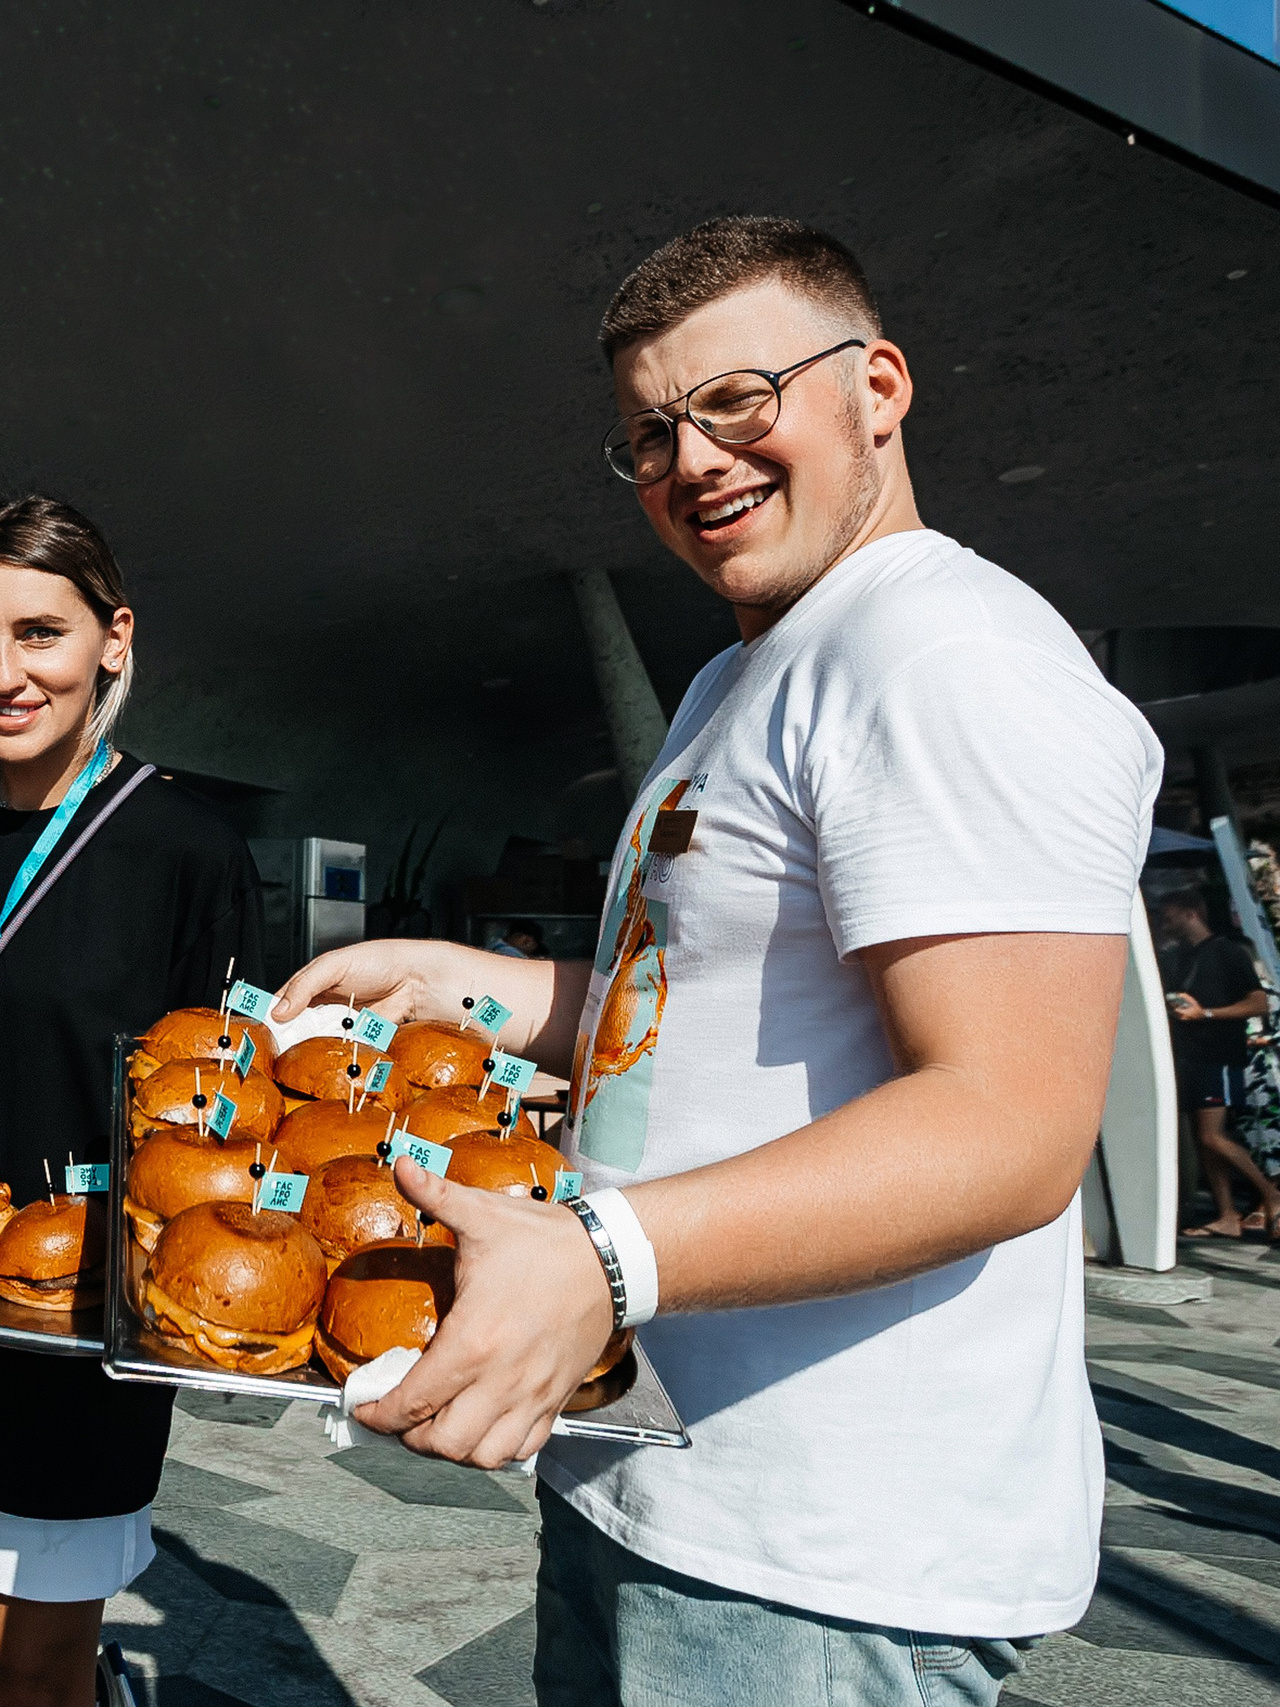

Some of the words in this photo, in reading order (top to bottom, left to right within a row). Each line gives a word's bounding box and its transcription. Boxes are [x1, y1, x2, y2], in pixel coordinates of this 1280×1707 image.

[244, 990, 259, 1002] ГАС
[240, 1003, 254, 1013] ЛИС
[242, 998, 257, 1008] ТРО
[484, 1009, 496, 1021] ТРО
[487, 1004, 500, 1016] ГАС
[370, 1018, 384, 1031] ГАС
[479, 1014, 492, 1026] ЛИС
[367, 1024, 381, 1035] ТРО
[363, 1030, 378, 1042] ЛИС
[505, 1062, 522, 1072] ГАС
[503, 1069, 519, 1079] ТРО
[499, 1076, 517, 1085] ЛИС
[410, 1143, 431, 1157] ГАС
[275, 1181, 293, 1191] ГАС
[274, 1190, 291, 1199] ТРО
[270, 1197, 287, 1207] ЛИС
